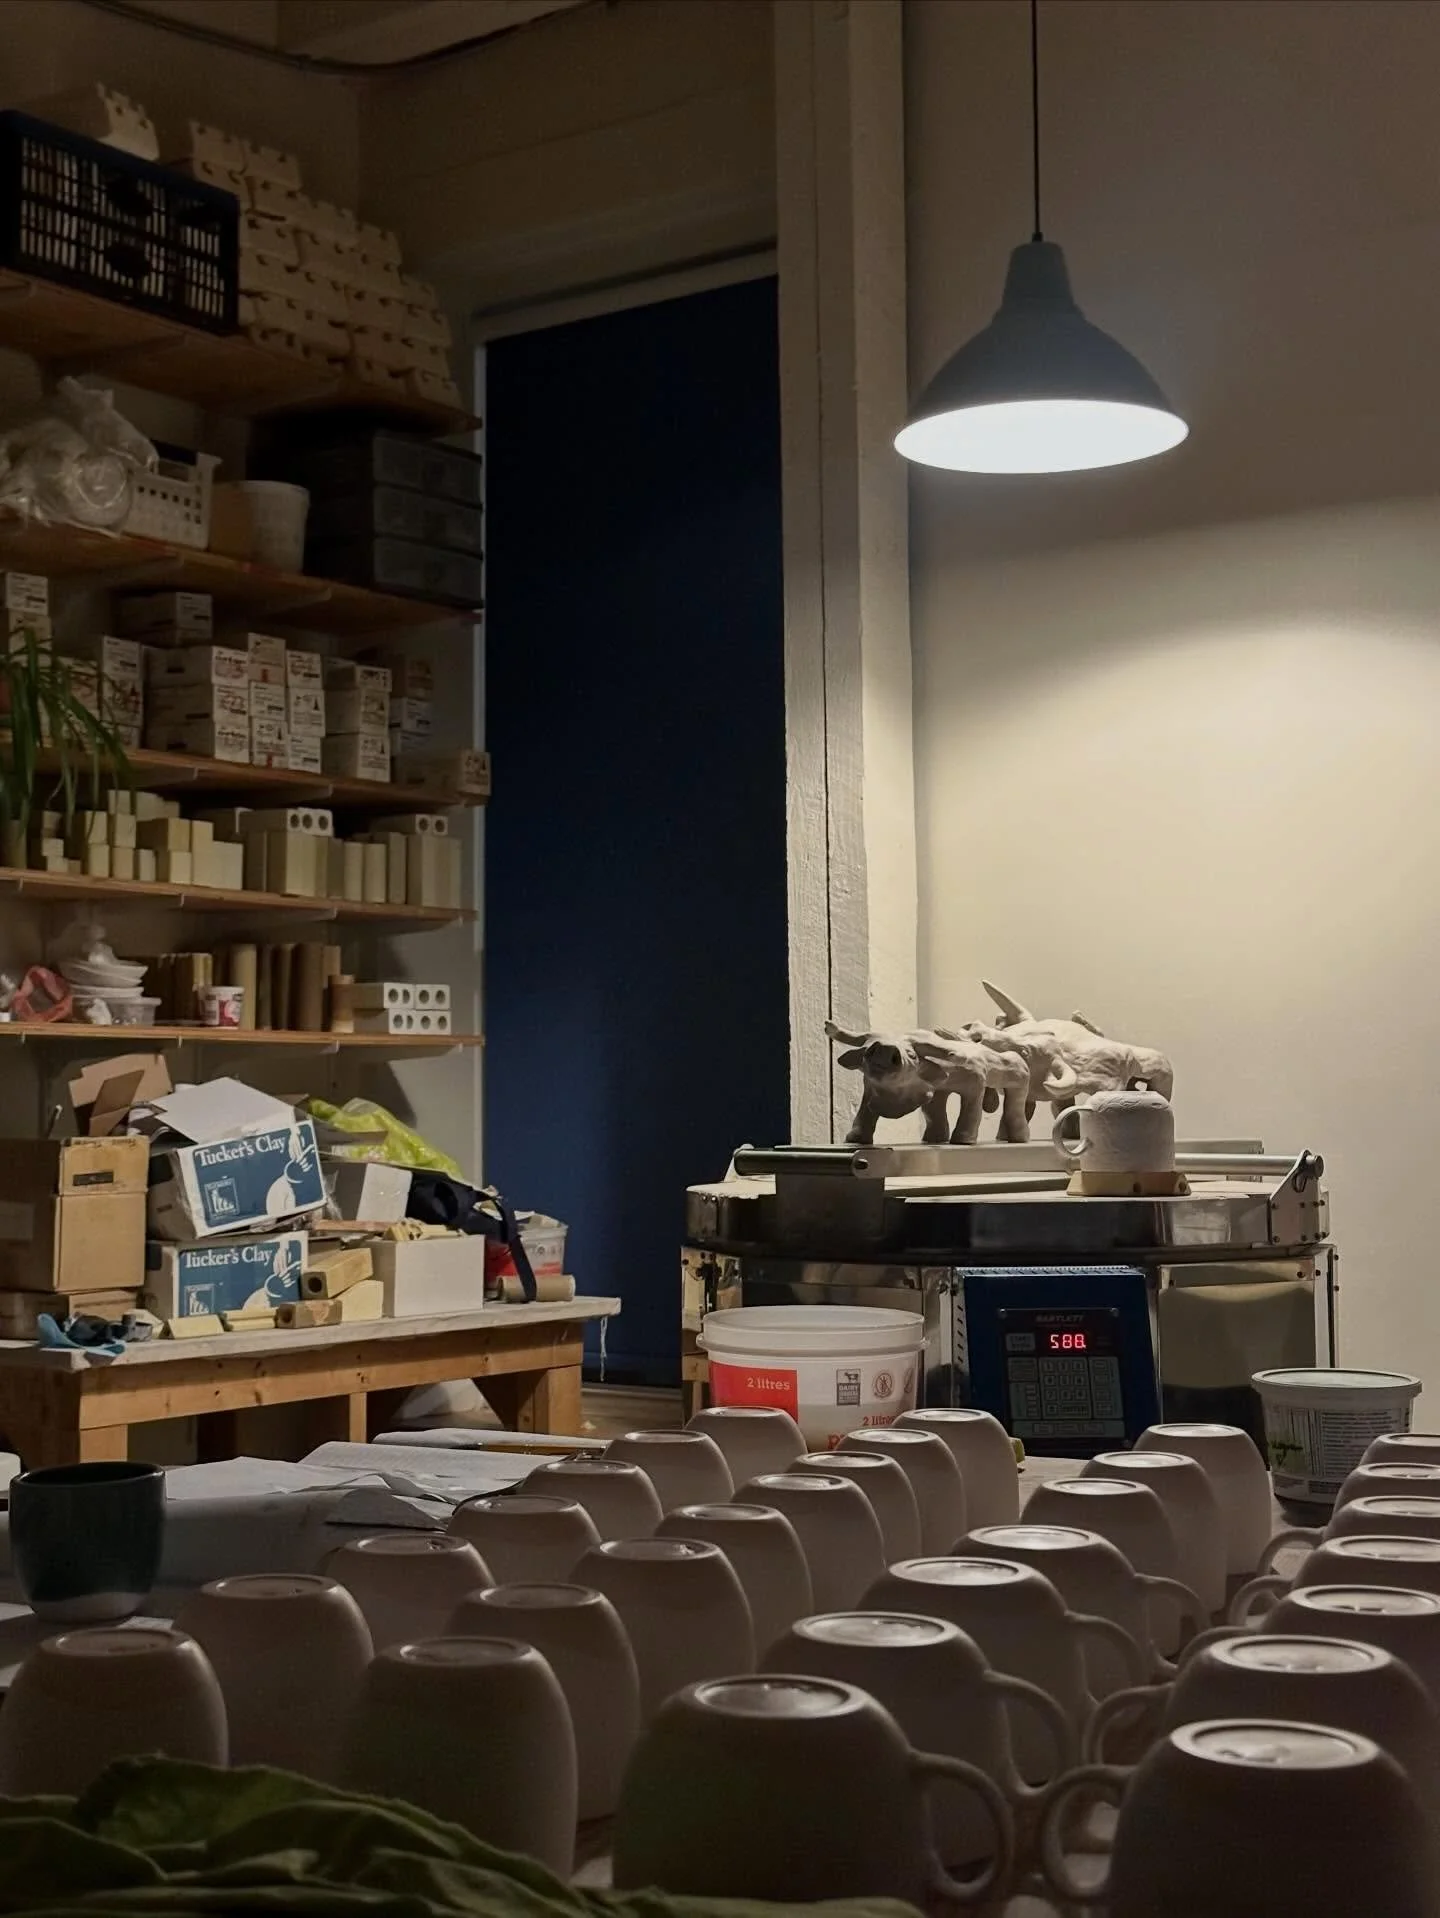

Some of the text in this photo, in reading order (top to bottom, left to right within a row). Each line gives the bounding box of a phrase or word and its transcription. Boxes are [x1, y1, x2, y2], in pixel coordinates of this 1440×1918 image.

[194, 1134, 287, 1167] Tucker's Clay
[180, 1245, 273, 1269] Tucker's Clay
[747, 1375, 791, 1390] 2 litres
[863, 1416, 870, 1426] 2
